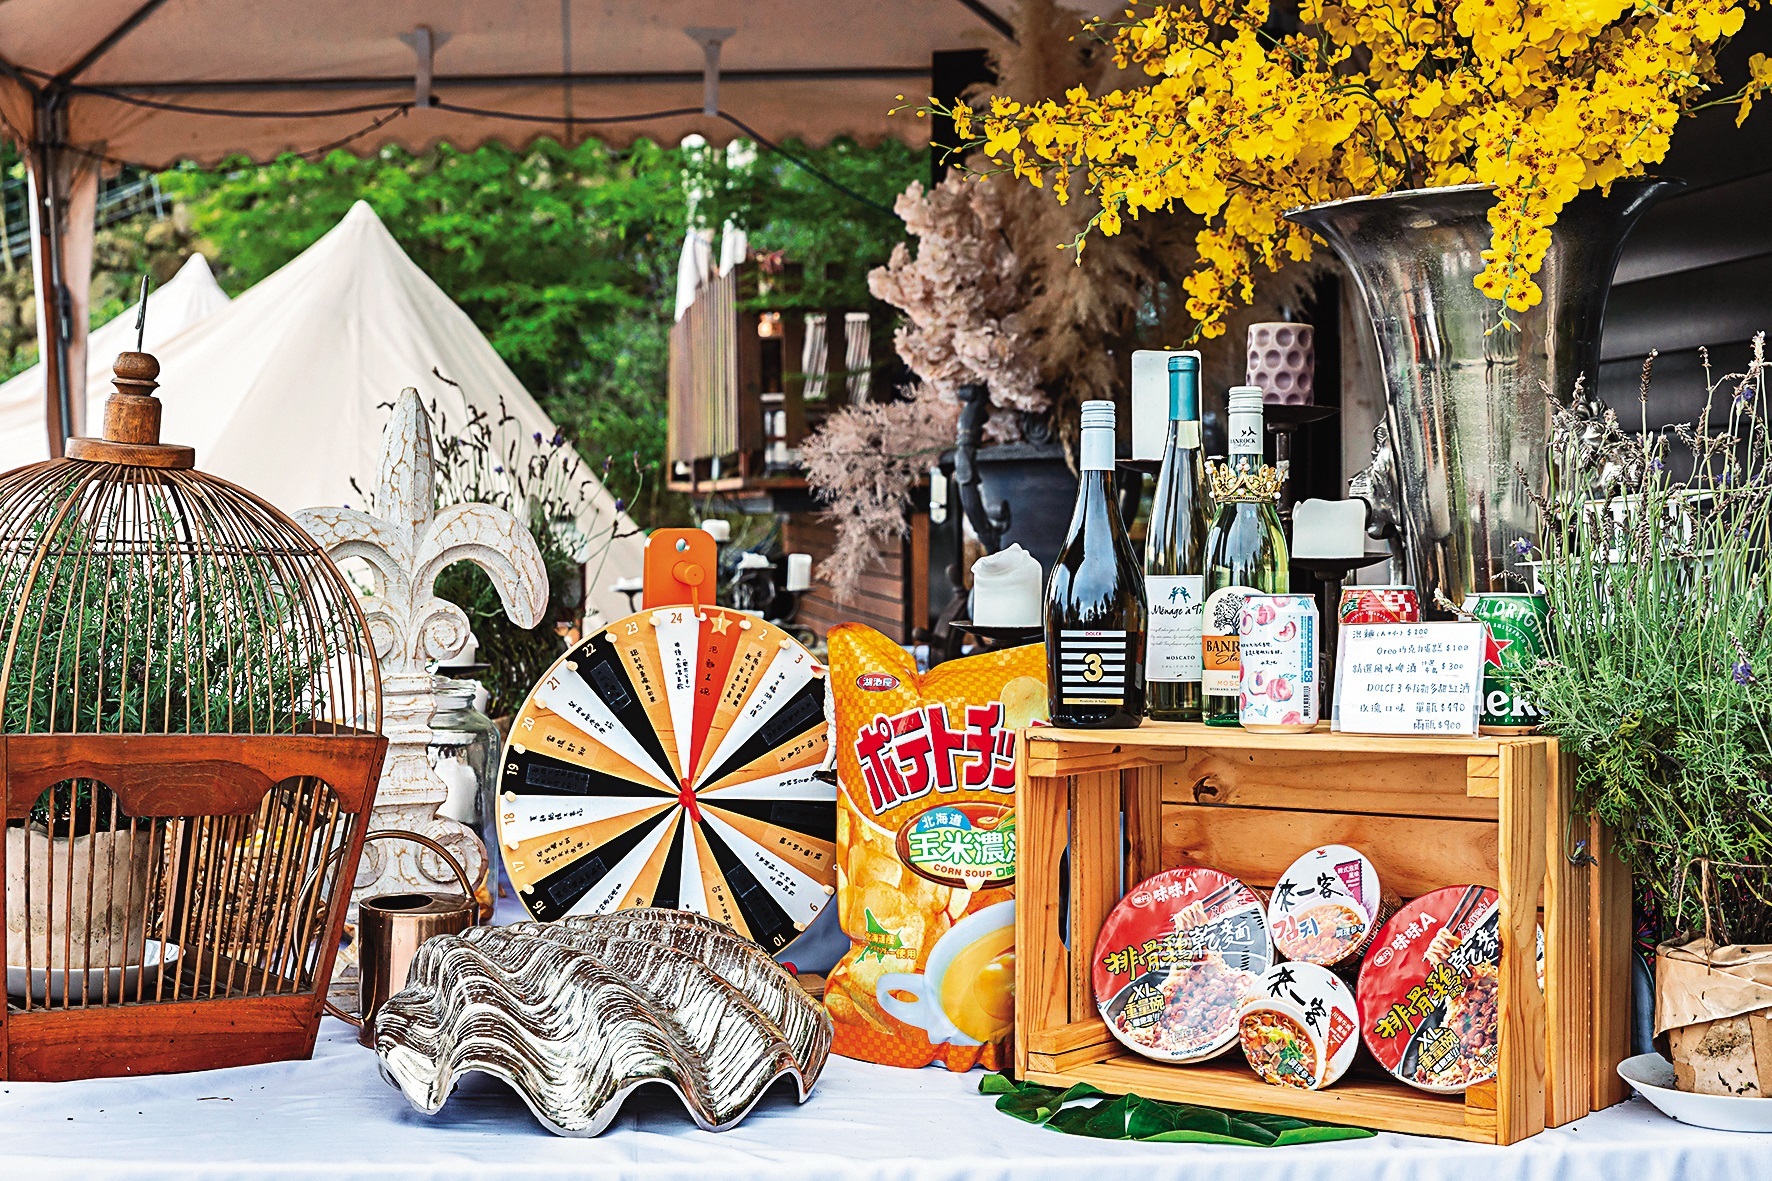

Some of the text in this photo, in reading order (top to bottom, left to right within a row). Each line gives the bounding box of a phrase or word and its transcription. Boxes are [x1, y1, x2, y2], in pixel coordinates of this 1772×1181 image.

[670, 612, 683, 624] 24
[1151, 604, 1183, 619] Ménage
[625, 621, 639, 635] 23
[717, 617, 723, 630] 1
[1492, 599, 1547, 655] ORIGINA
[758, 628, 768, 640] 2
[582, 643, 597, 658] 22
[1206, 640, 1240, 652] BANR
[794, 653, 804, 664] 3
[1215, 650, 1240, 665] Sta
[1083, 652, 1103, 682] 3
[1441, 662, 1464, 670] $300
[546, 676, 561, 691] 21
[863, 677, 893, 687] 湖池屋
[1360, 702, 1405, 713] 玫瑰口味
[521, 716, 535, 732] 20
[855, 703, 1016, 812] ポテトチッ
[506, 763, 519, 776] 19
[503, 812, 516, 825] 18
[922, 812, 963, 829] 北海道
[512, 860, 526, 873] 17
[934, 863, 993, 878] CORN SOUP
[1153, 877, 1199, 903] 味味A
[1275, 872, 1344, 912] 來一客
[532, 900, 547, 915] 16
[1273, 915, 1319, 943] 김치
[1391, 911, 1438, 951] 味味A
[773, 933, 786, 947] 10
[1133, 983, 1157, 1000] XL
[1124, 994, 1166, 1019] 重量碗
[1267, 966, 1327, 1037] 來一客
[1416, 1027, 1444, 1051] XL
[1418, 1028, 1461, 1071] 重量碗
